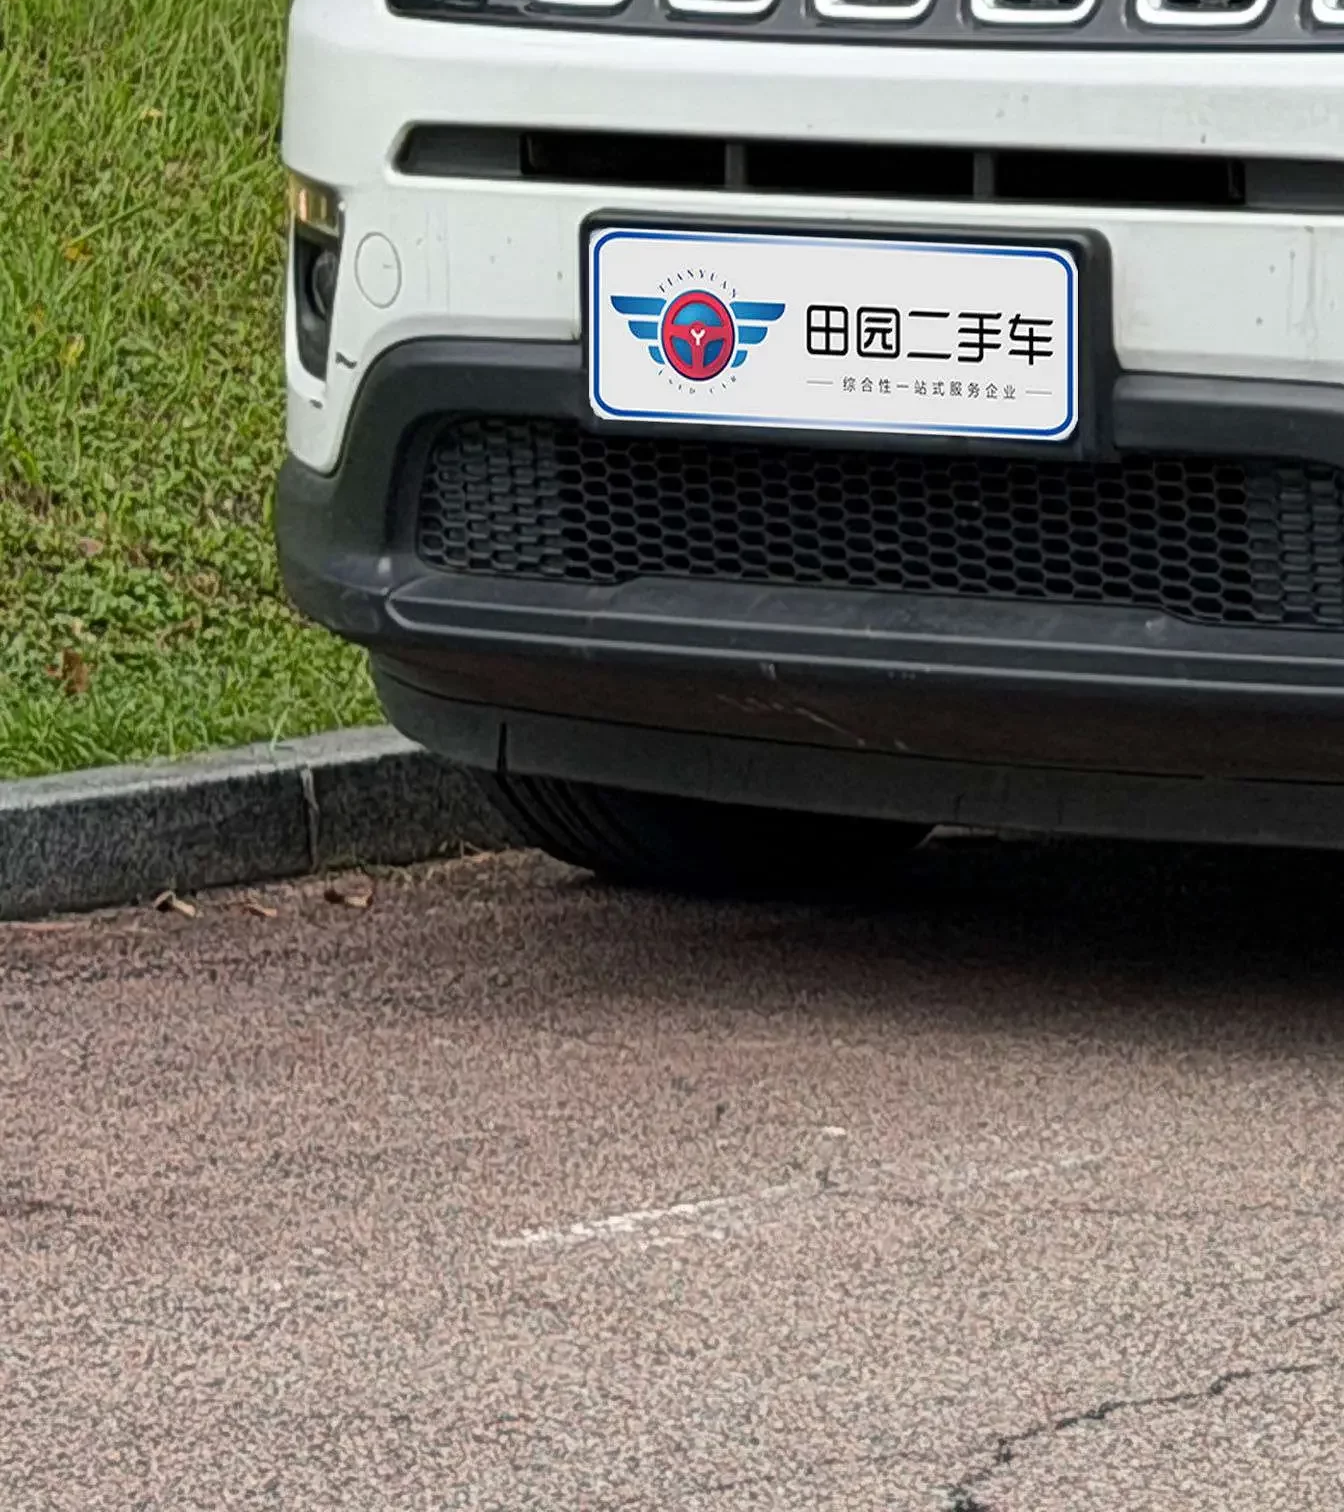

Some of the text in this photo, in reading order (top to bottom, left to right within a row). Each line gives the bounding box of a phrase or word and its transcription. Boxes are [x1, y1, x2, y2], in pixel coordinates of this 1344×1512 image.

[806, 304, 1054, 366] 田园二手车
[842, 376, 1017, 400] 综合性一站式服务企业
